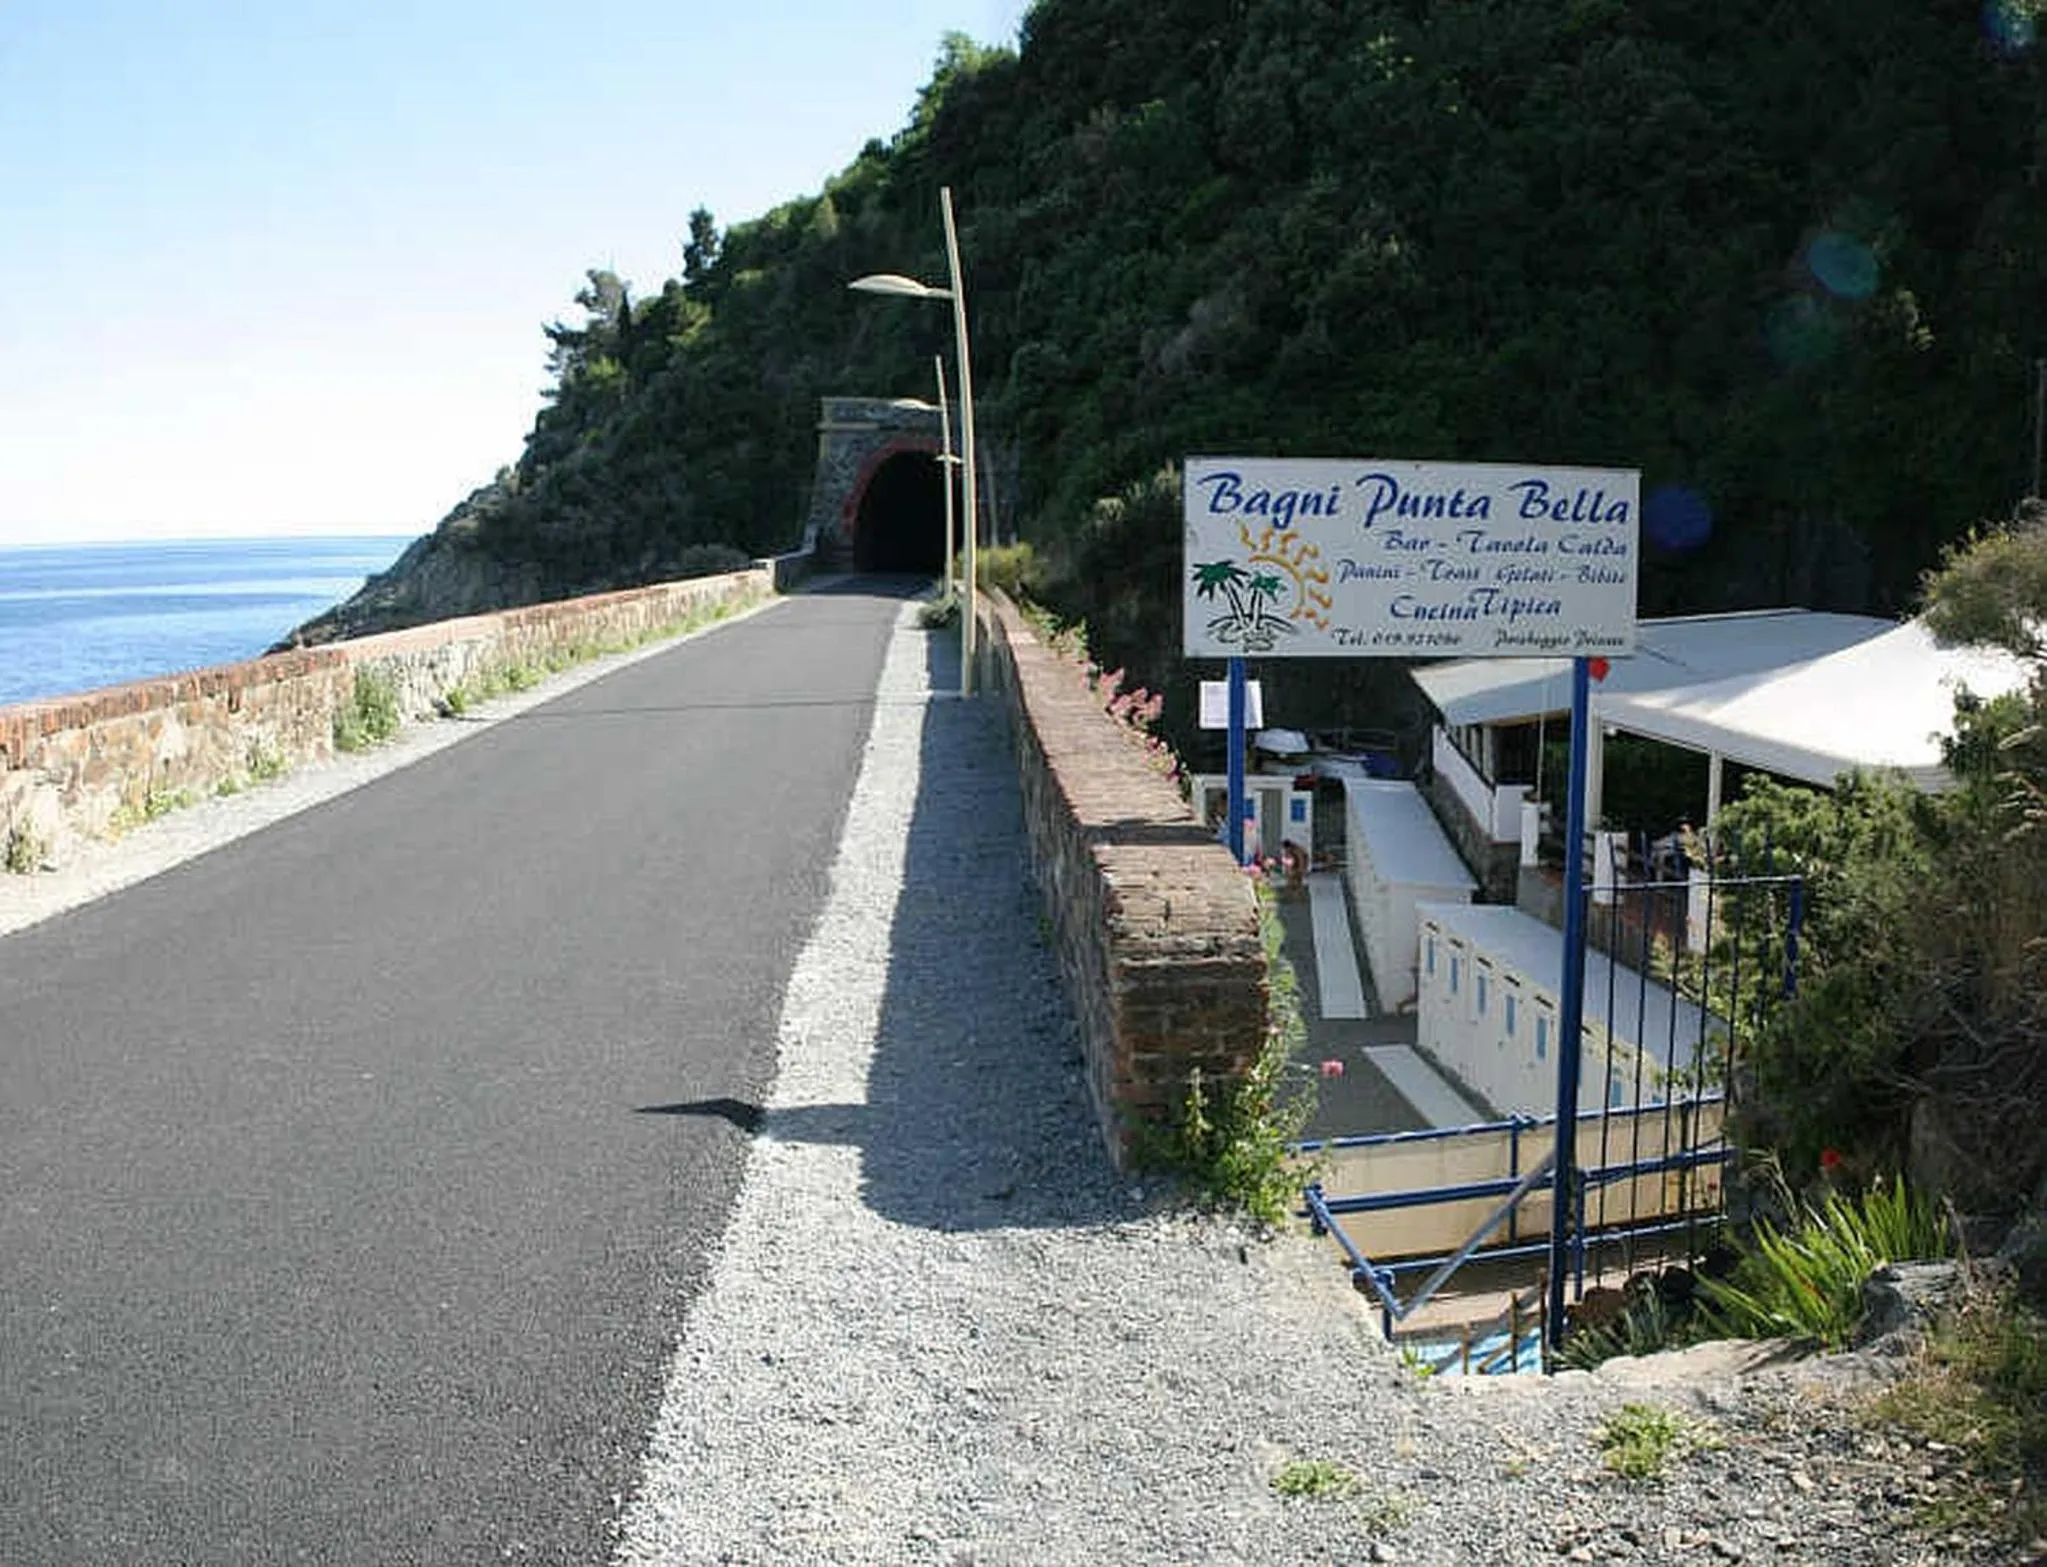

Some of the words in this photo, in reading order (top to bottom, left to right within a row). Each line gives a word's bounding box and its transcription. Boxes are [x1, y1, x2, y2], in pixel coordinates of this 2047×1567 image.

[1197, 472, 1342, 529] Bagni
[1355, 472, 1491, 529] Punta
[1508, 479, 1631, 525] Bella
[1380, 529, 1431, 552] Bar
[1456, 529, 1549, 554] Tavola
[1557, 533, 1628, 556] Calda
[1336, 558, 1401, 584] Panini
[1389, 594, 1479, 621] Cucina
[1467, 587, 1562, 624] Tipica
